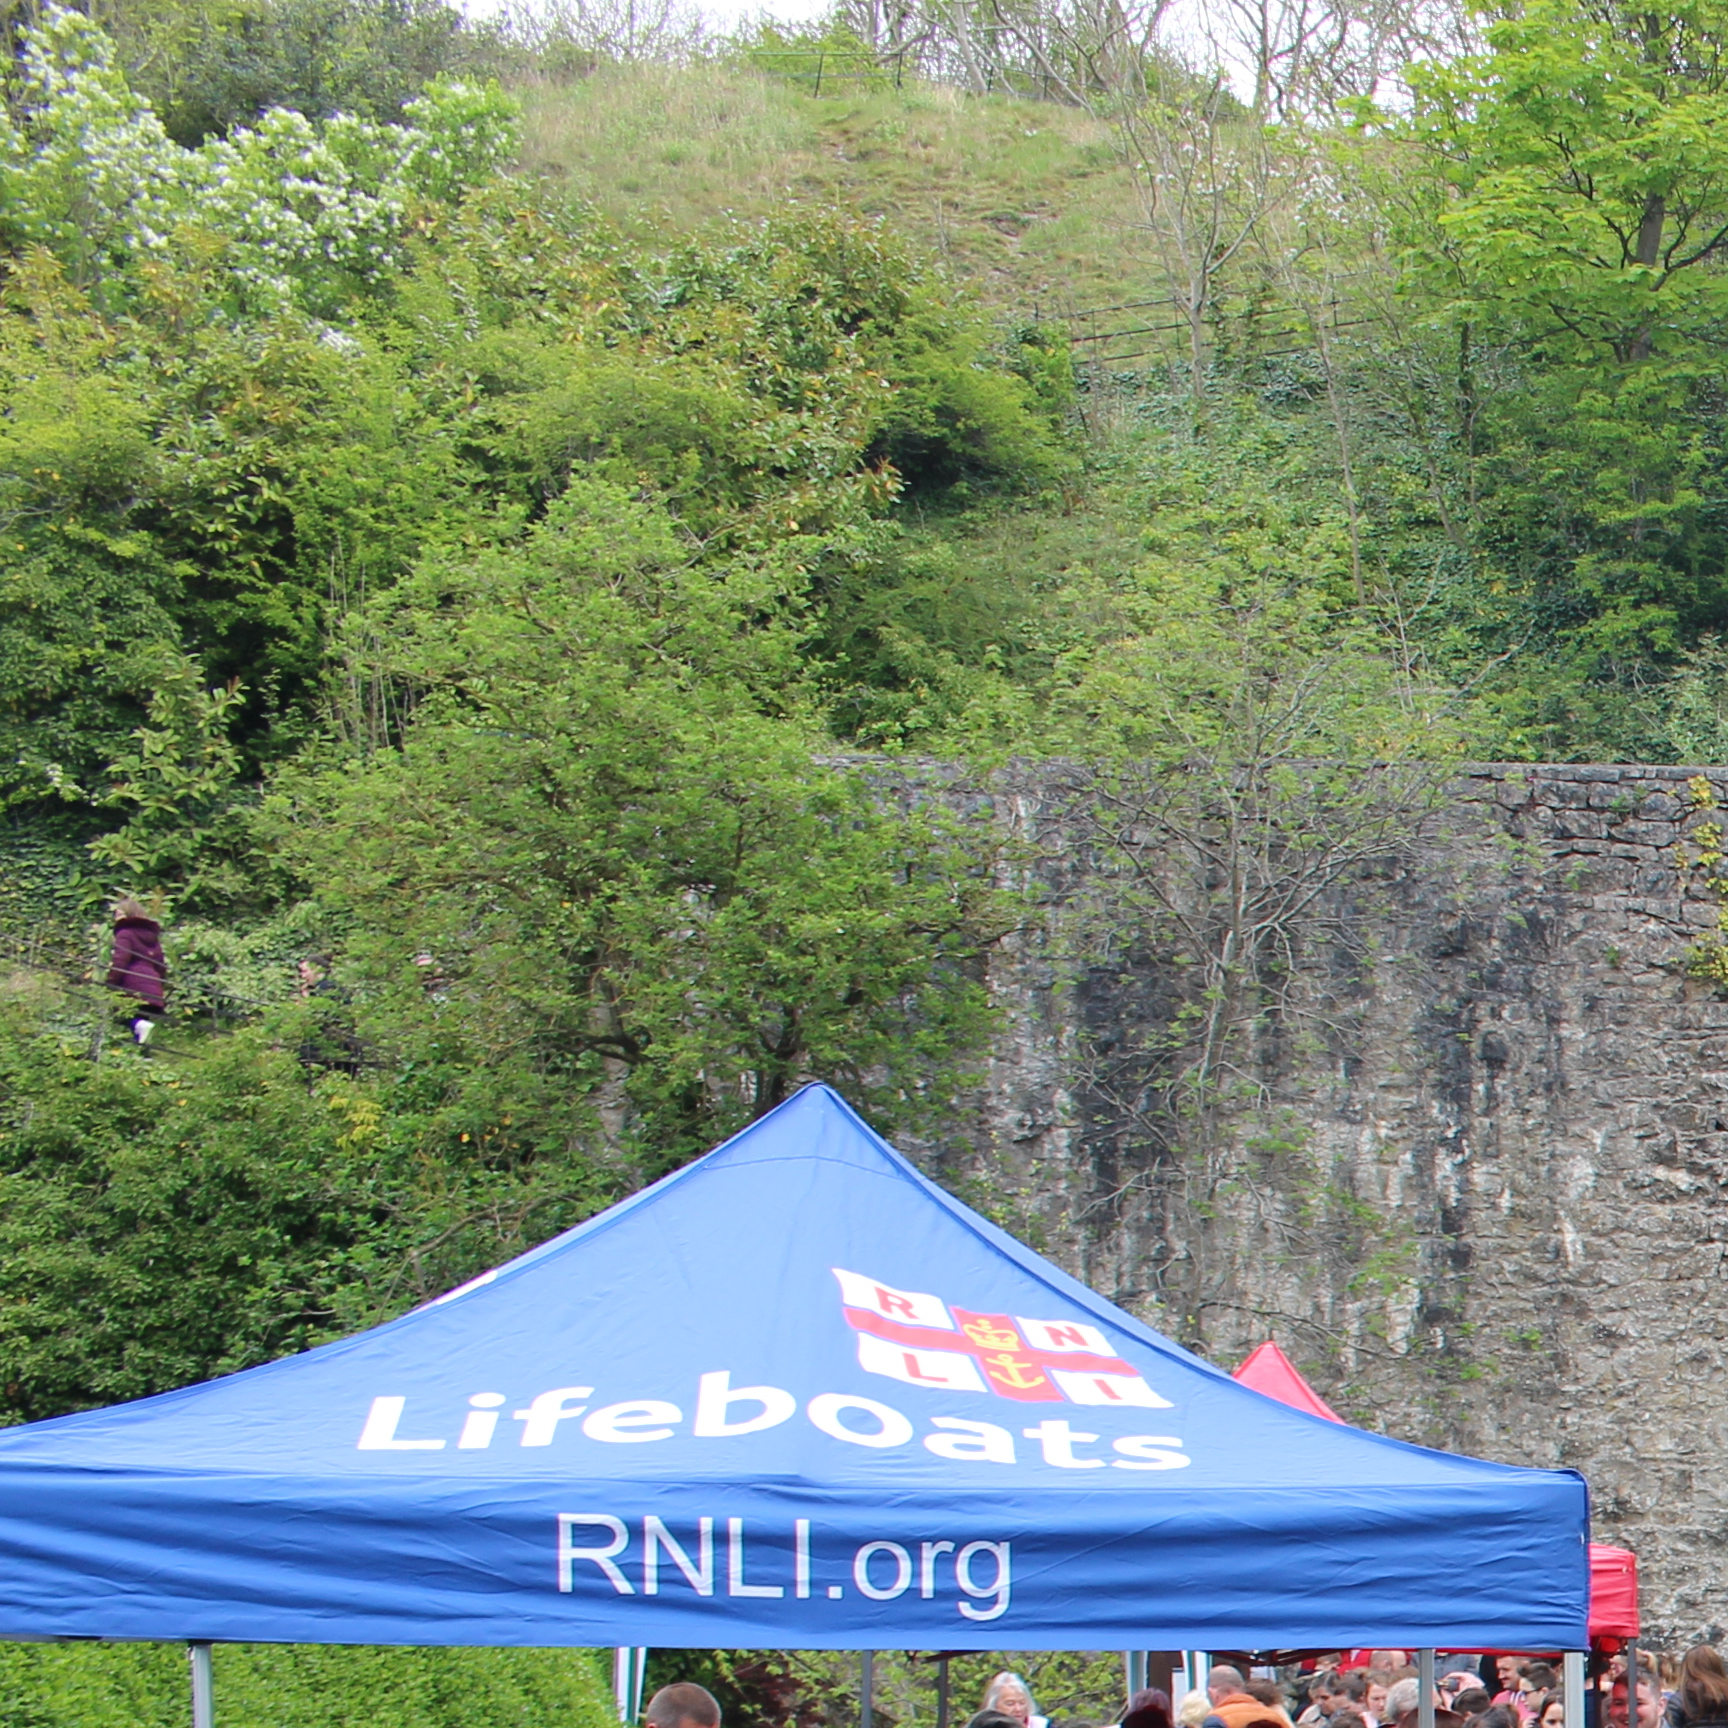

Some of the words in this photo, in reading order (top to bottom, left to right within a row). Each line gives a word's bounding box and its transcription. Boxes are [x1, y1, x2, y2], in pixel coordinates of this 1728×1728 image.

[874, 1285, 920, 1320] R
[1043, 1325, 1090, 1348] N
[903, 1353, 950, 1383] L
[1093, 1378, 1123, 1401] I
[357, 1370, 1192, 1471] Lifeboats
[556, 1511, 1013, 1622] RNLI.org
